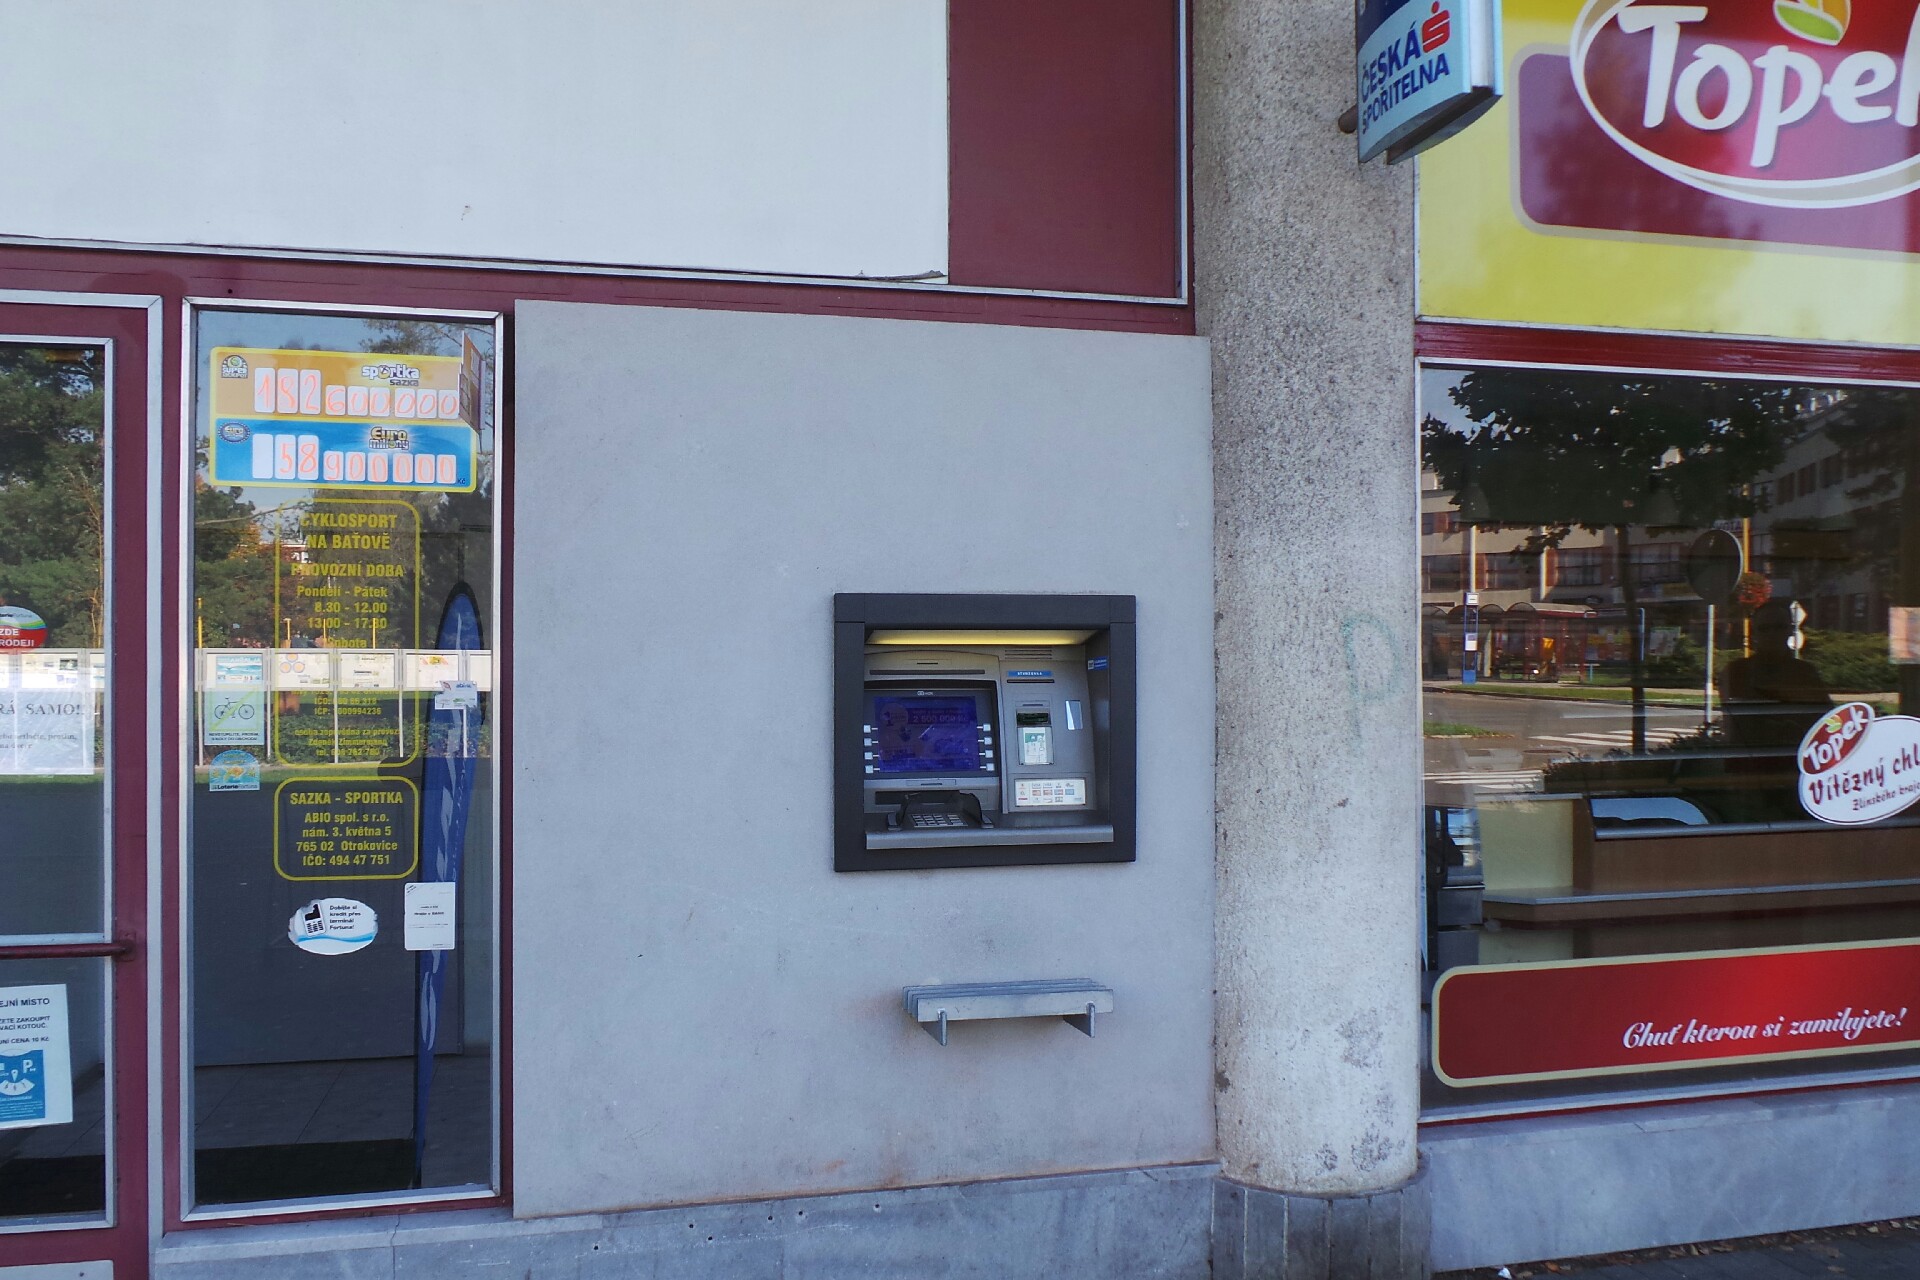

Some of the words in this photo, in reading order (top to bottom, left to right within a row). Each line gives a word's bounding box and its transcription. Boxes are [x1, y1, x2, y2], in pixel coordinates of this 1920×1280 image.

[1361, 20, 1421, 103] ČESKÁ
[1362, 53, 1450, 135] SPOŘITELNA
[362, 364, 420, 380] sportka
[301, 512, 398, 528] CYKLOSPORT
[306, 534, 328, 548] NA
[332, 532, 390, 550] BAŤOVĚ
[291, 561, 362, 576] PROVOZNÍ
[366, 564, 404, 576] DOBA
[354, 586, 388, 597] Pátek
[314, 602, 341, 612] 8.30
[354, 602, 388, 613] 12.00
[1802, 706, 1869, 771] Topek
[1808, 757, 1884, 805] Vítězný
[290, 792, 331, 804] SAZKA
[345, 792, 403, 804] SPORTKA
[304, 813, 330, 822] ABIO
[334, 812, 359, 824] spol.
[302, 826, 329, 837] nám.
[332, 827, 343, 837] 3.
[346, 826, 381, 837] května
[385, 826, 392, 836] 5
[296, 842, 317, 852] 765
[320, 842, 334, 851] 02
[341, 840, 398, 851] Otrokovice
[303, 854, 326, 866] IČO:
[329, 856, 350, 866] 494
[353, 855, 366, 865] 47
[370, 855, 390, 865] 751
[21, 998, 50, 1006] MÍSTO
[1682, 1018, 1758, 1044] kterou
[1762, 1016, 1785, 1037] si
[1788, 1007, 1908, 1040] zamilujete!
